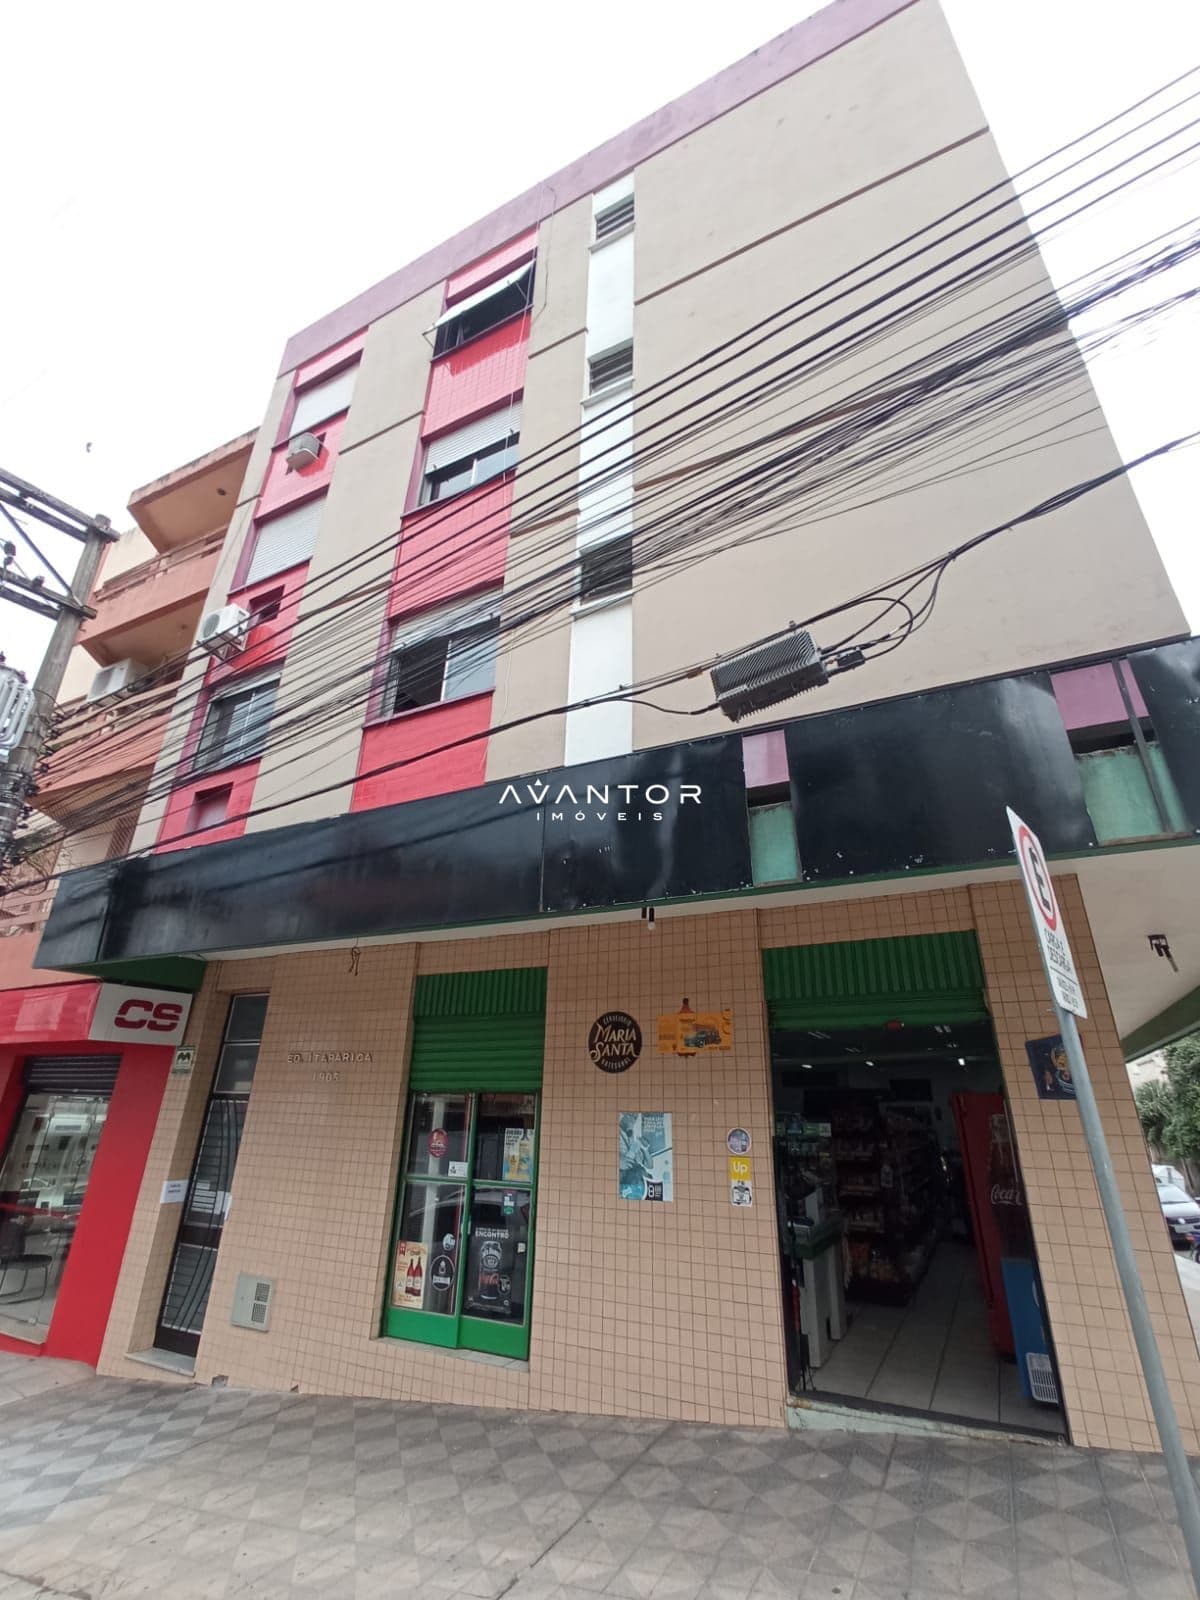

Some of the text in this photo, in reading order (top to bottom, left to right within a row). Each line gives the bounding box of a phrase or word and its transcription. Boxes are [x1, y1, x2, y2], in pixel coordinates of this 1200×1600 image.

[114, 999, 183, 1032] CS
[594, 1022, 637, 1043] MARIA
[308, 1051, 373, 1063] ITAPARICA
[590, 1041, 640, 1063] SANTA
[475, 1231, 510, 1240] ENCONTRO
